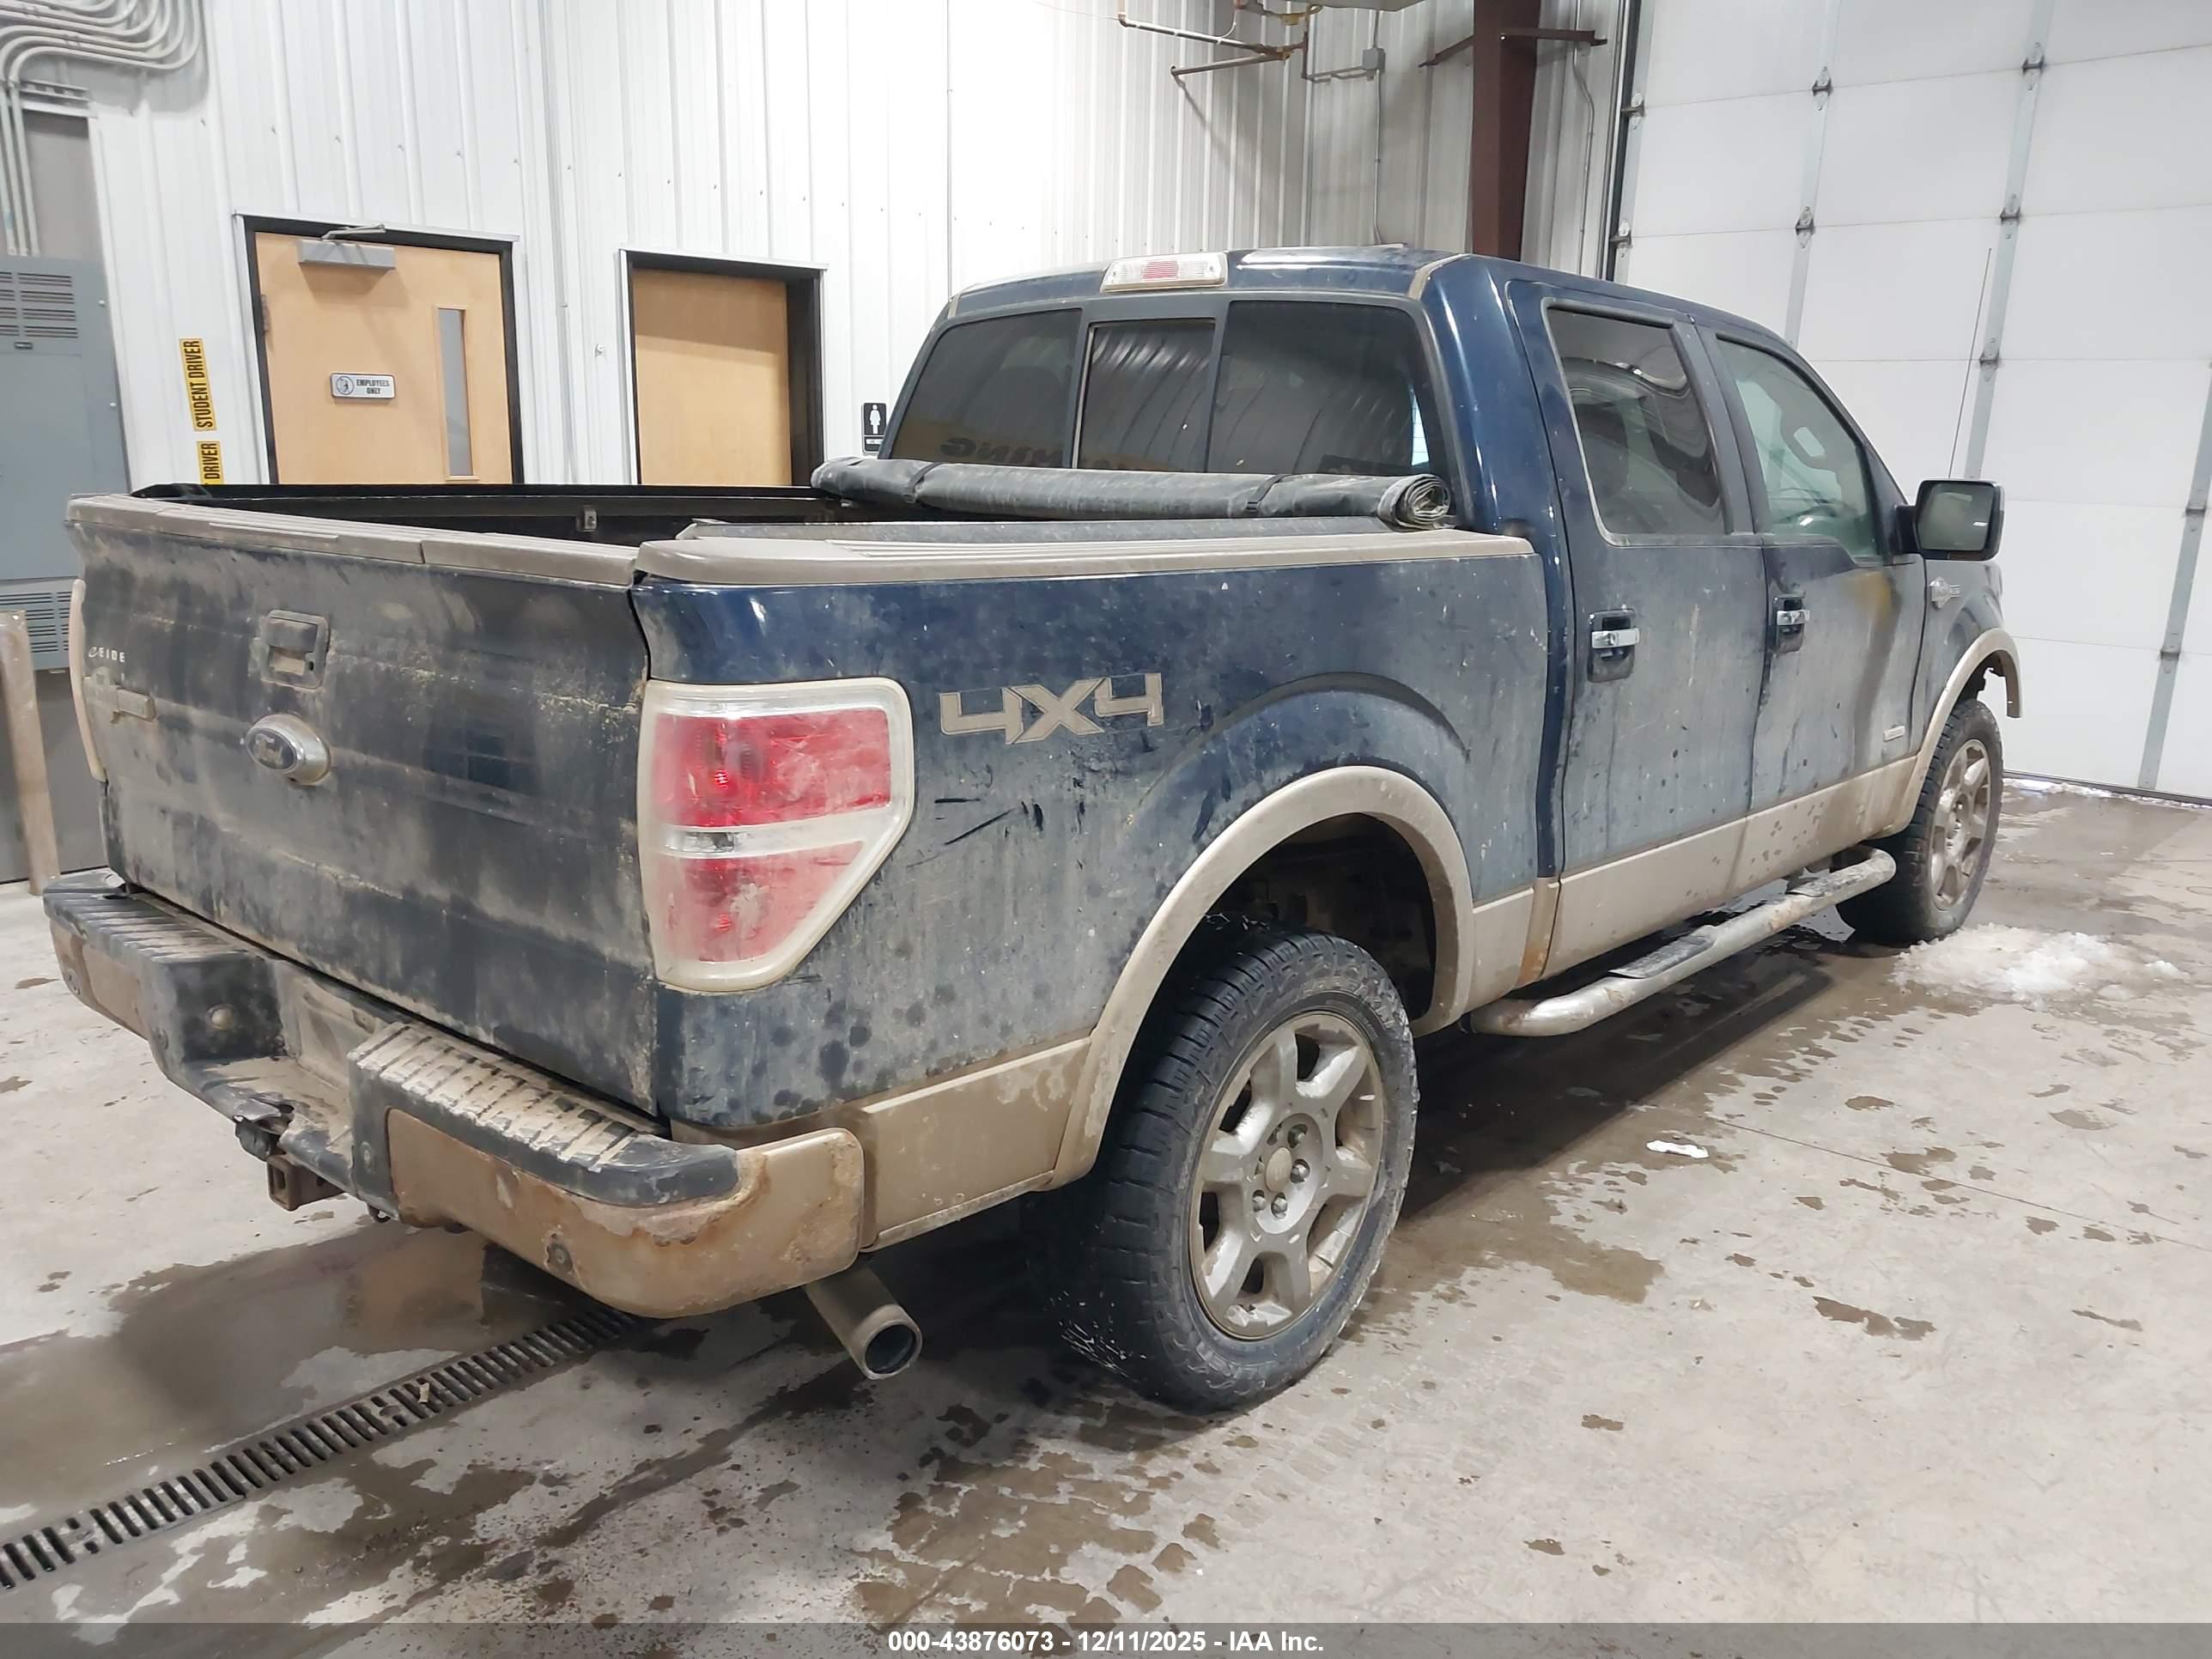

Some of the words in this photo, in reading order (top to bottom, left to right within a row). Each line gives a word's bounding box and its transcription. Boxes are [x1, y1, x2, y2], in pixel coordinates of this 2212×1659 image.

[183, 340, 205, 379] DRIVER
[190, 381, 214, 428] STUDENT
[366, 386, 381, 395] ONLY
[200, 442, 221, 480] DRIVER
